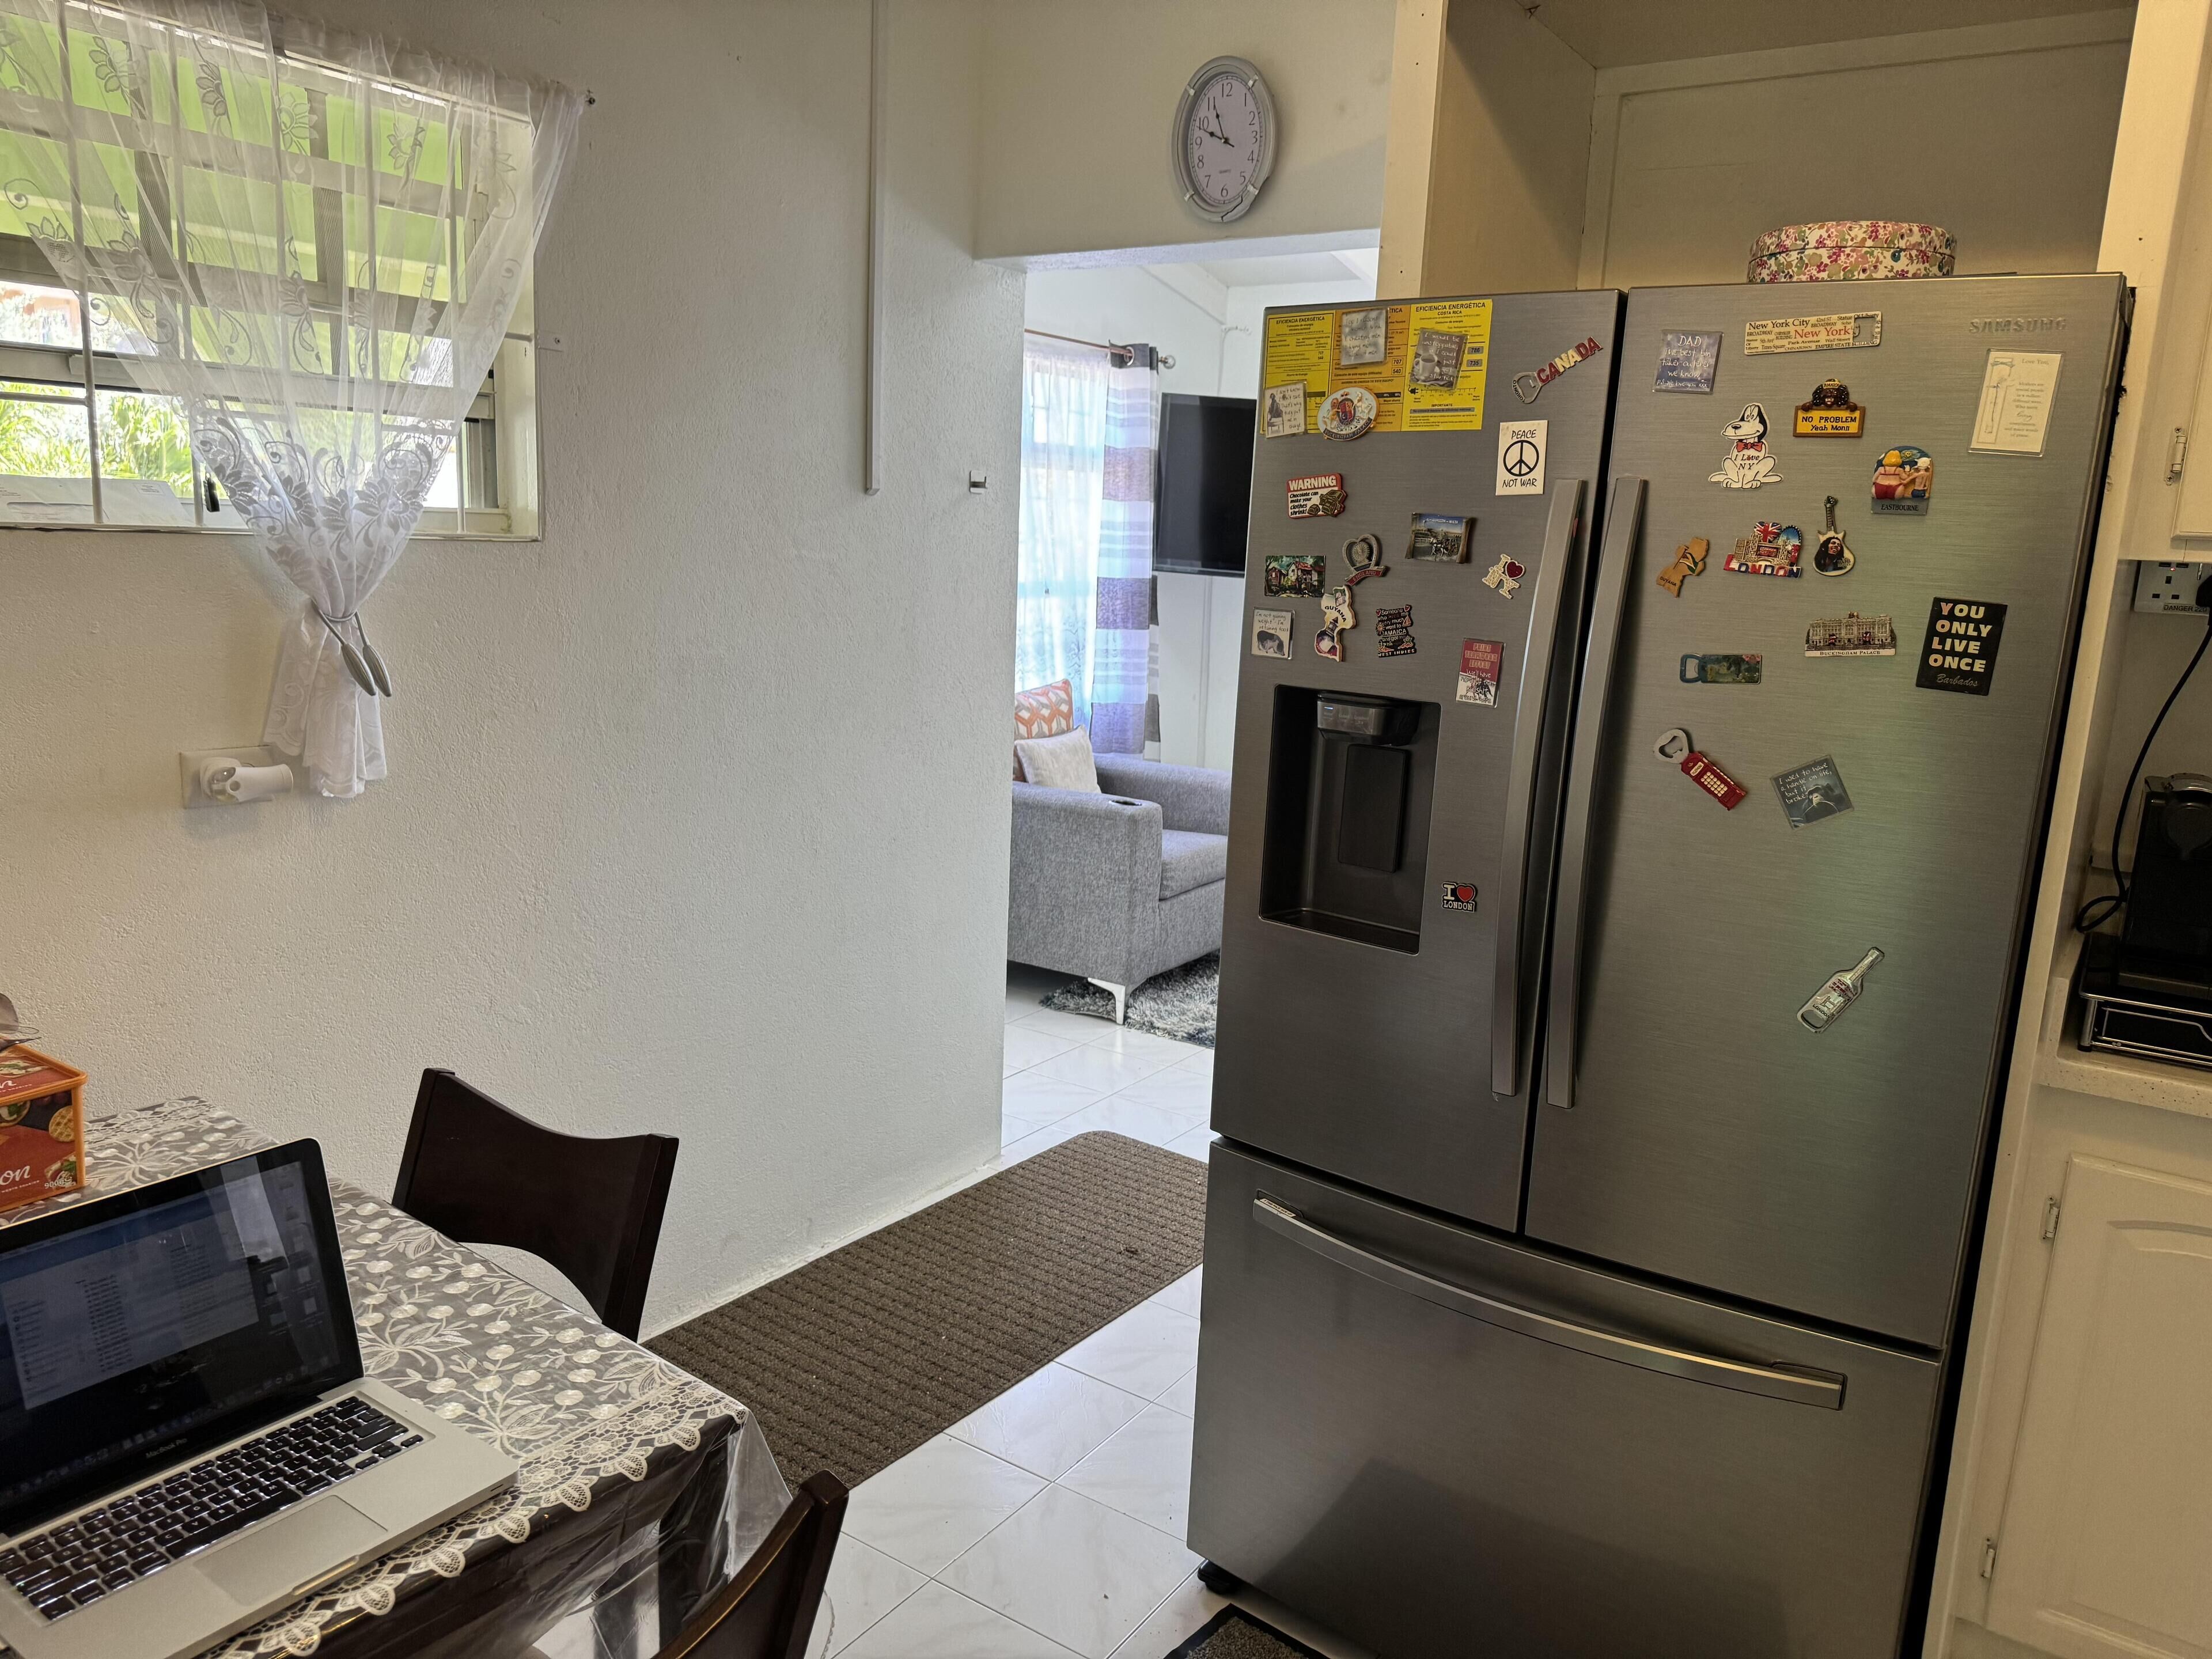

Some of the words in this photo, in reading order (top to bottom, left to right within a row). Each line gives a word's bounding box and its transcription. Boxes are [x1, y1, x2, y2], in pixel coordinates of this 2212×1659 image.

[1222, 82, 1233, 97] 12
[1208, 96, 1215, 111] 11
[1198, 116, 1209, 131] 10
[1249, 111, 1255, 125] 2
[1195, 136, 1202, 150] 9
[1252, 131, 1257, 144] 3
[1198, 155, 1204, 169] 8
[1248, 150, 1254, 164] 4
[1205, 175, 1211, 188] 7
[1240, 172, 1246, 185] 5
[1221, 184, 1228, 198] 6
[1771, 320, 1790, 328] York
[1793, 319, 1810, 328] City
[1969, 317, 2066, 333] SAMSUNG
[1794, 329, 1821, 339] New
[1824, 325, 1850, 336] York
[1678, 335, 1702, 346] DAD
[1536, 336, 1604, 384] CANADA
[1680, 349, 1696, 358] best
[1680, 370, 1701, 379] know
[1512, 429, 1536, 440] PEACE
[1289, 475, 1336, 490] WARNING
[1502, 479, 1518, 488] NOT
[1520, 478, 1537, 487] WAR
[1498, 554, 1510, 572] I
[1723, 554, 1802, 578] LONDON
[1353, 570, 1376, 581] ENGLAND
[1482, 565, 1521, 599] NY
[1660, 576, 1677, 586] GUYANA
[1324, 605, 1347, 623] GUYANA
[1940, 602, 1985, 619] YOU
[1936, 620, 1993, 637] ONLY
[1931, 637, 1981, 654] LIVE
[1929, 654, 1986, 672] ONCE
[1936, 673, 1979, 687] Barbados
[1785, 773, 1800, 782] used
[1812, 762, 1828, 771] have
[1786, 778, 1806, 789] handle
[1820, 769, 1832, 777] life,
[1785, 788, 1798, 797] but
[1444, 884, 1455, 900] I
[1443, 900, 1473, 910] LONDON
[1812, 1003, 1830, 1018] LONDON
[145, 1442, 176, 1459] MacBook
